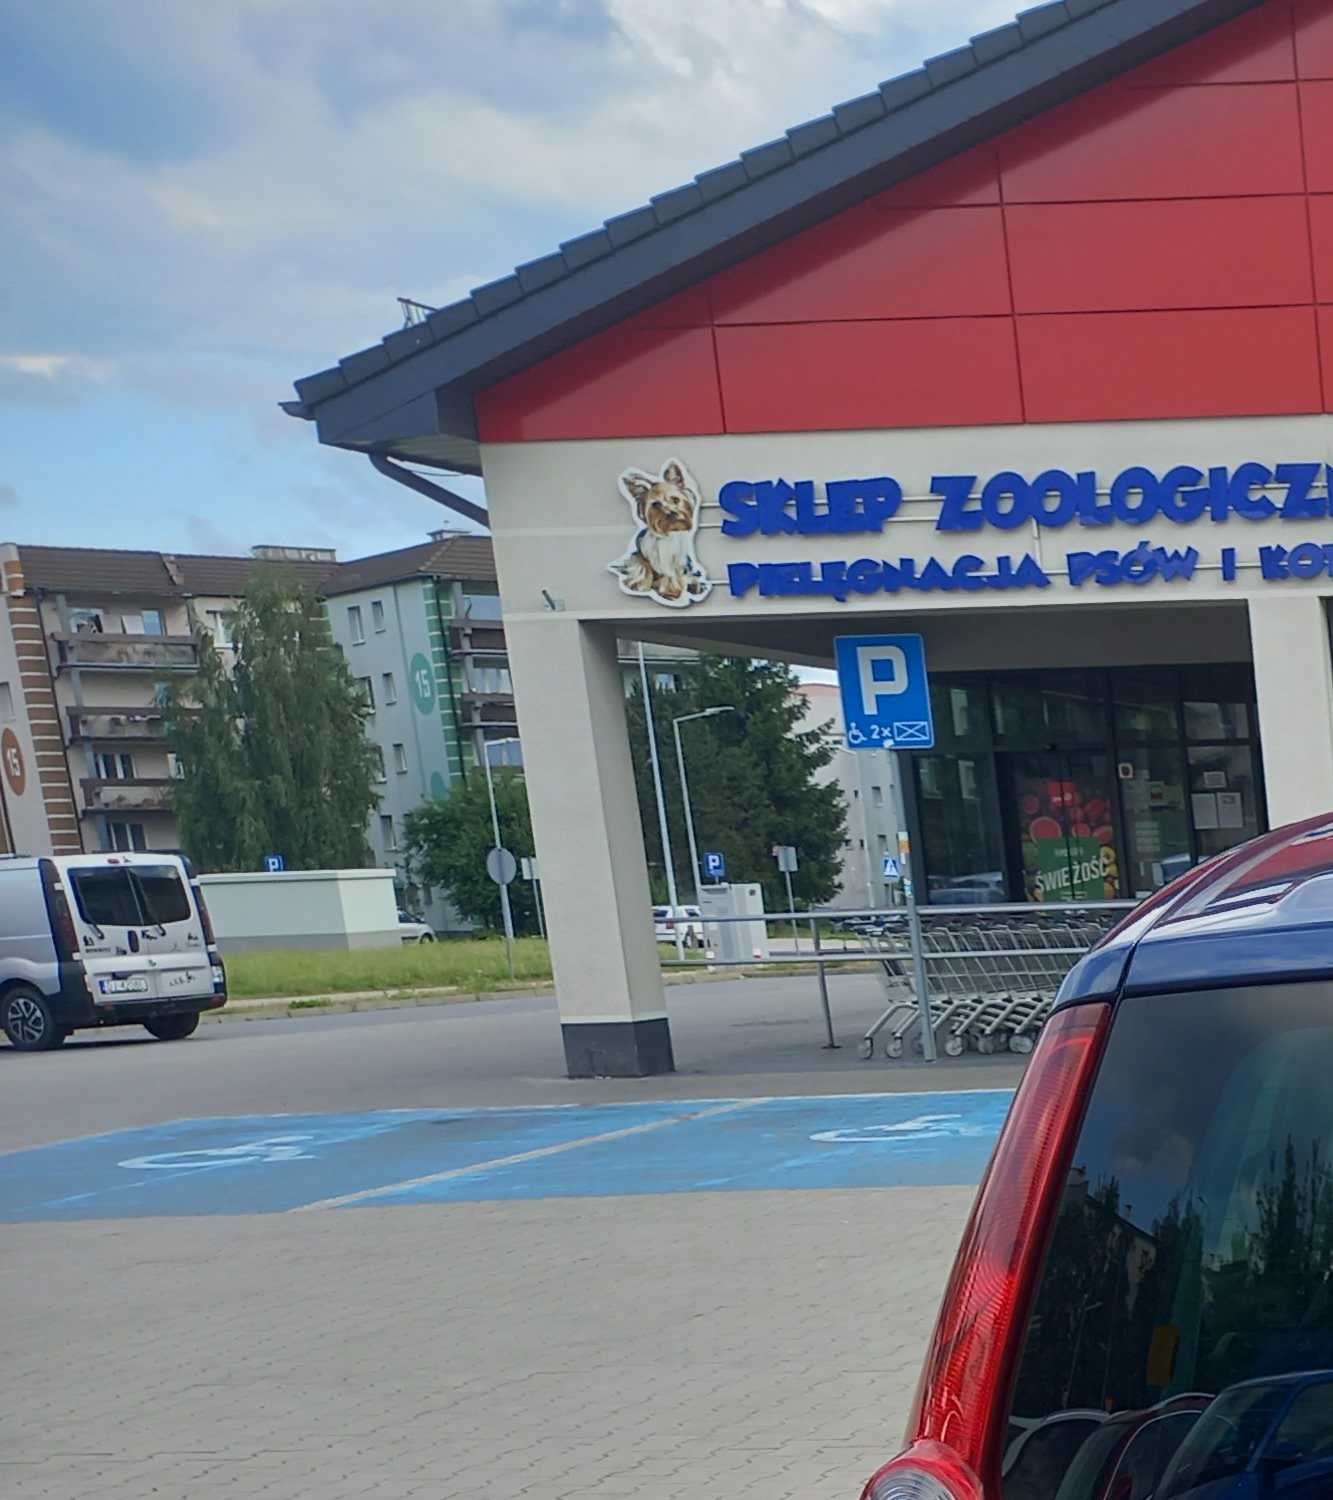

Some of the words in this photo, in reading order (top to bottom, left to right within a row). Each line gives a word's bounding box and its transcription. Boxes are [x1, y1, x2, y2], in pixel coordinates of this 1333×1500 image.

[719, 477, 903, 537] SKLEP
[727, 553, 1052, 602] PIELĘGNACJA
[1066, 541, 1199, 586] PSÓW
[1221, 547, 1236, 581] I
[415, 669, 431, 698] 15
[856, 645, 909, 715] P
[870, 725, 892, 739] 2x
[7, 748, 21, 776] 15
[269, 858, 279, 872] P
[708, 855, 719, 870] P
